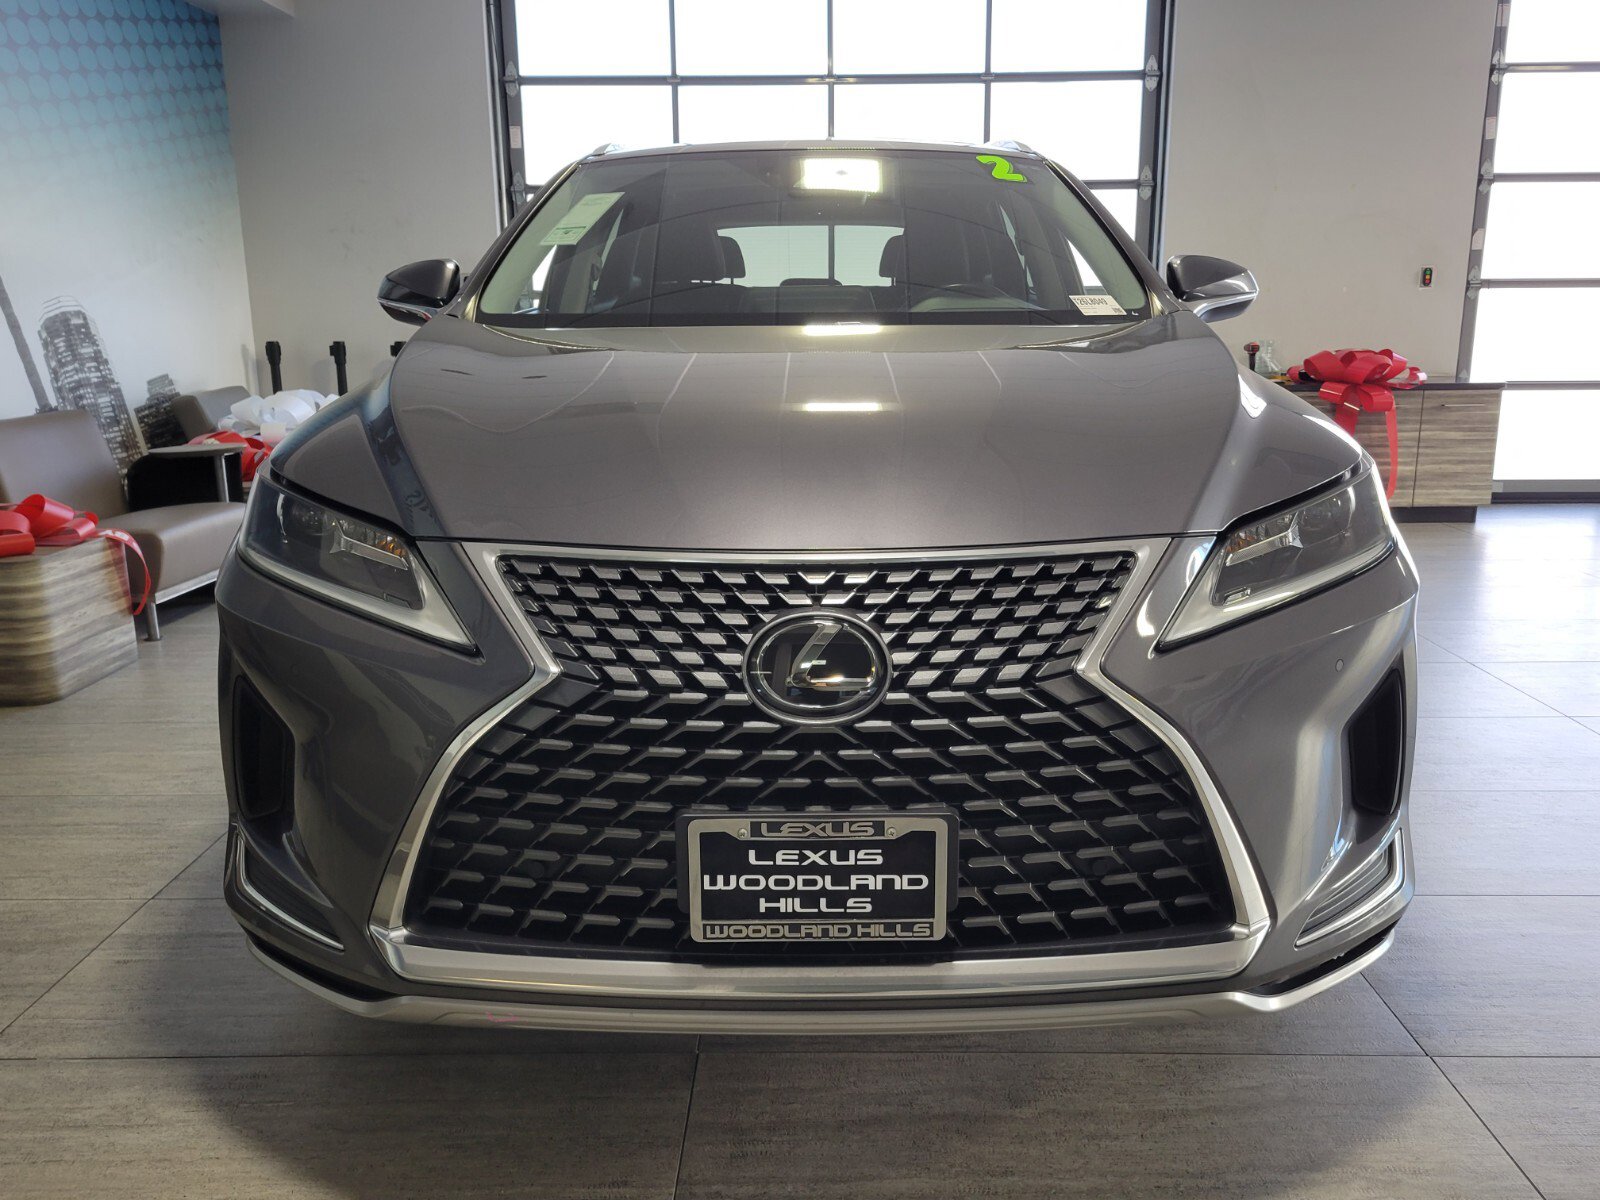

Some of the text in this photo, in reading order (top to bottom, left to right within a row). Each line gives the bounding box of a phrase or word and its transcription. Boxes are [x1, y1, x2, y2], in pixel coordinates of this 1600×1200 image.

[976, 155, 1027, 182] 2
[760, 822, 875, 838] LEXUS
[748, 849, 884, 866] LEXUS
[703, 874, 929, 891] WOODLAND
[759, 897, 873, 913] HILLS
[706, 923, 931, 938] WOODLAND HILLS
